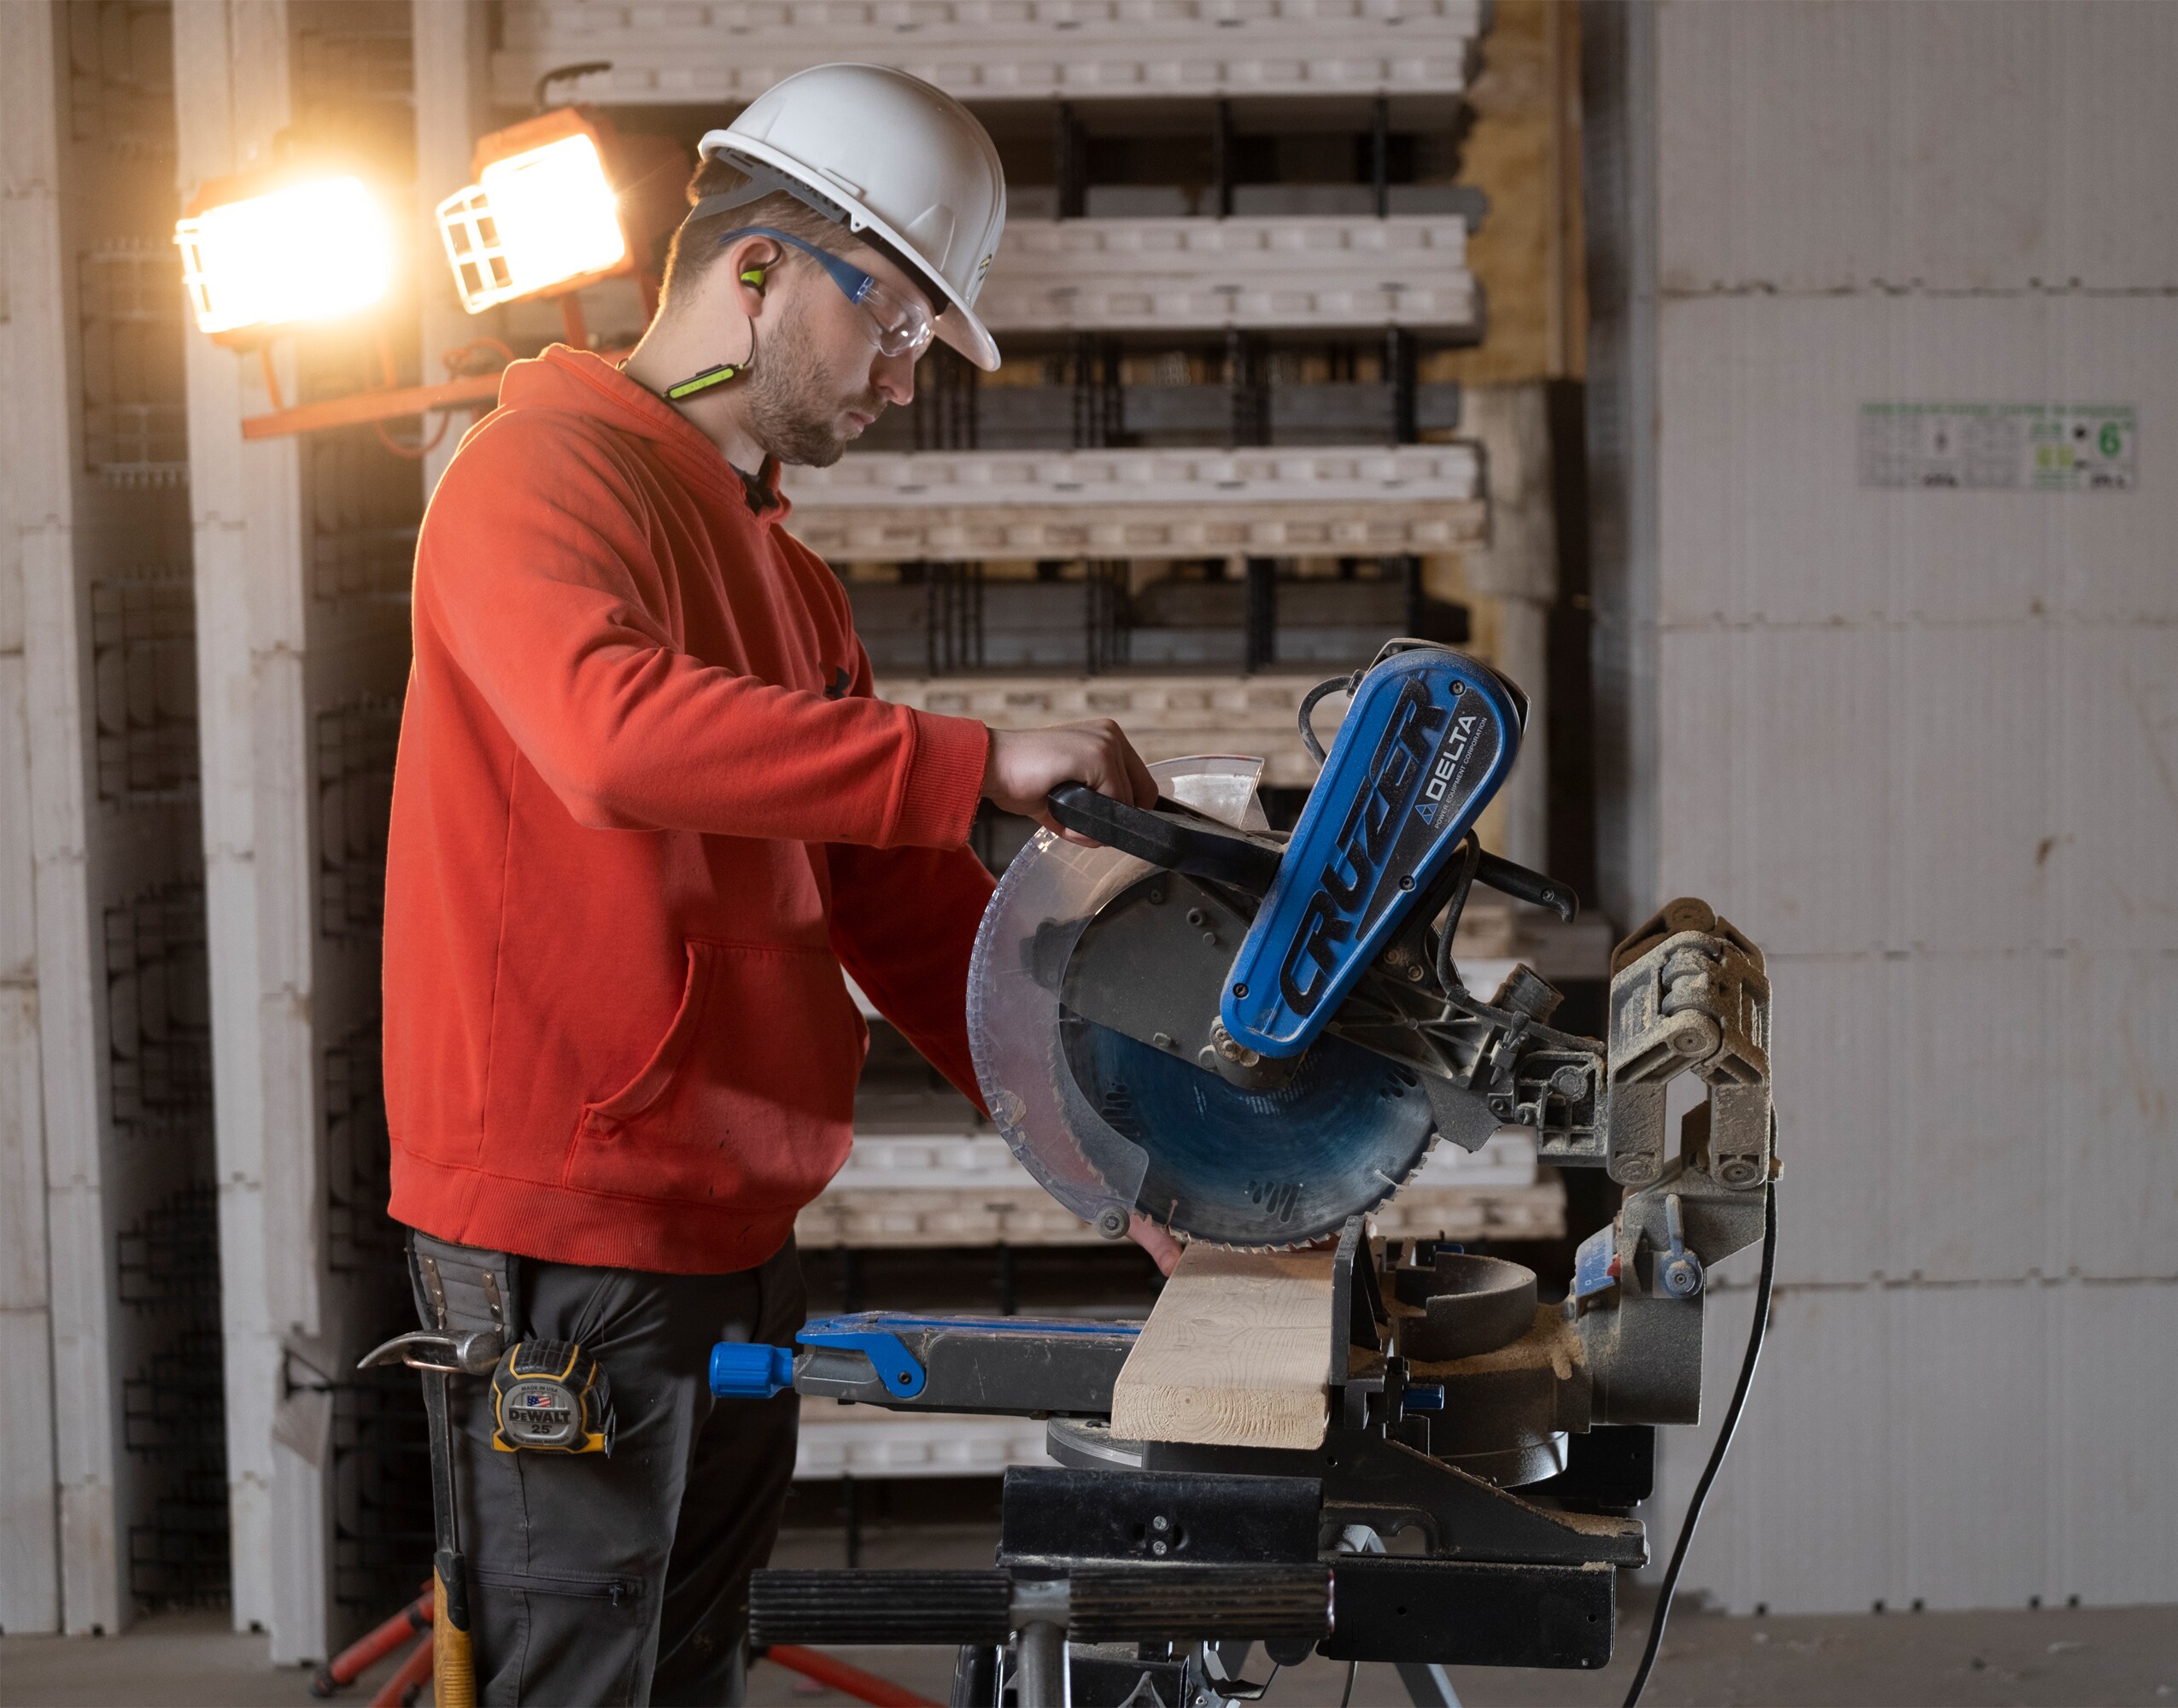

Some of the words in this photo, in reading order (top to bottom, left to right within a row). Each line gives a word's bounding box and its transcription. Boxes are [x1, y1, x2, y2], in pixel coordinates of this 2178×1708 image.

[1426, 715, 1477, 801] DELTA
[1434, 804, 1449, 829] POWER
[1446, 765, 1467, 804] EQUIPMENT
[1463, 717, 1488, 765] CORPORATION
[1279, 680, 1446, 1015] CRUZER
[544, 1435, 570, 1444] MATERIALS
